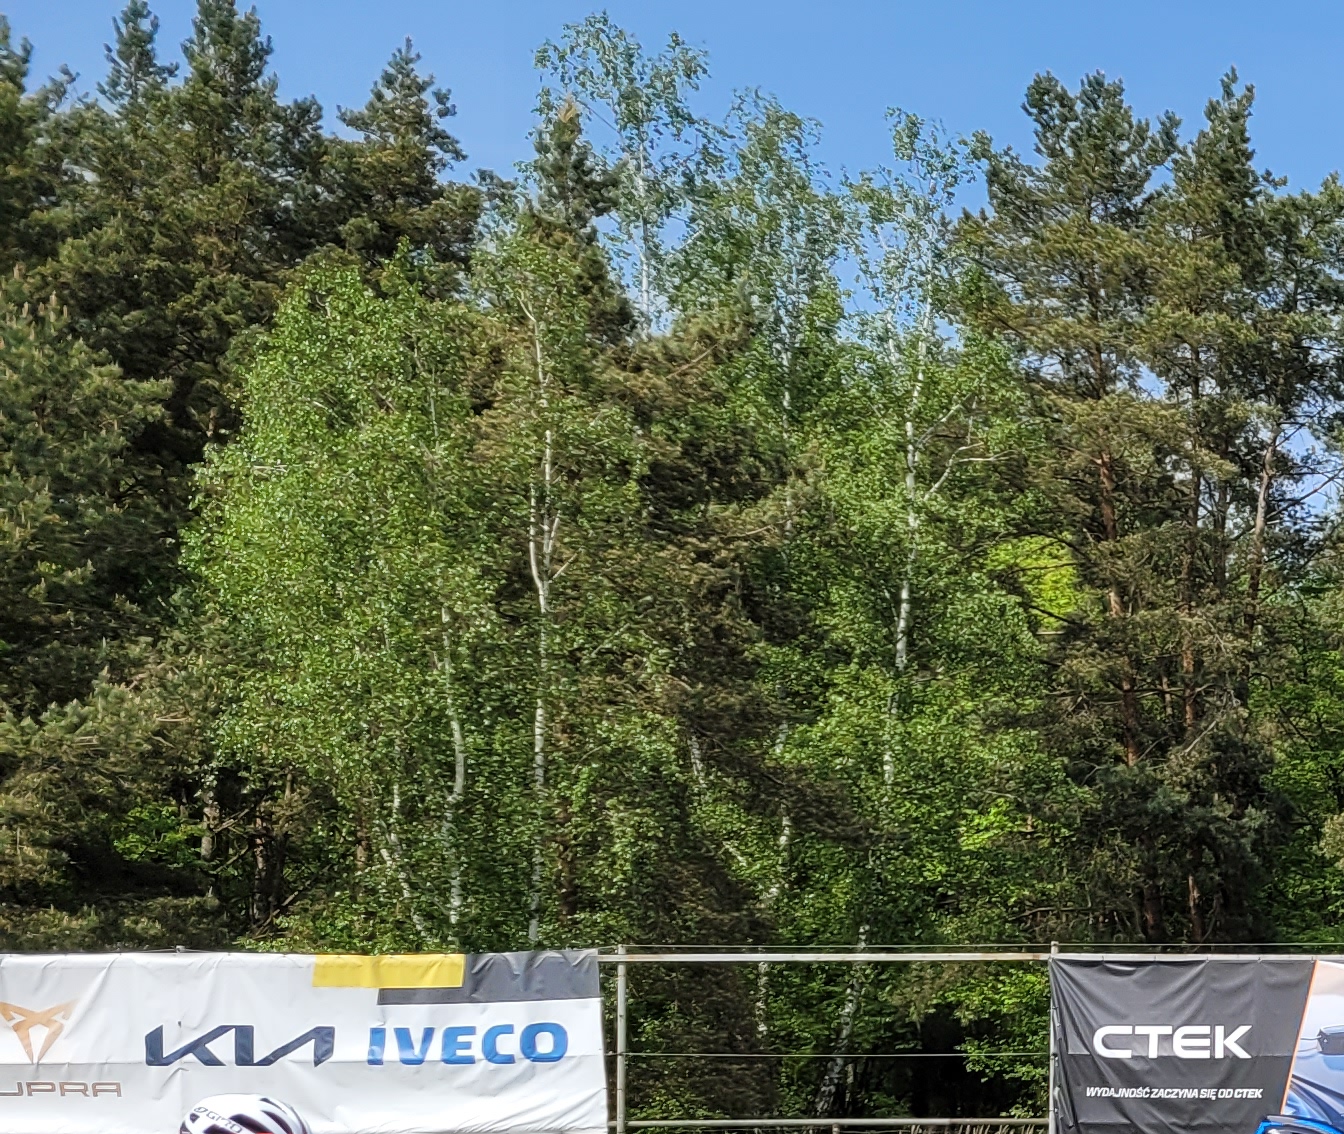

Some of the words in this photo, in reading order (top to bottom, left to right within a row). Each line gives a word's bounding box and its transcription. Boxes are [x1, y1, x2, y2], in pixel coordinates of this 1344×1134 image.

[367, 1022, 568, 1066] IVECO
[1092, 1024, 1254, 1060] CTEK
[0, 1081, 122, 1097] UPRA
[1085, 1086, 1151, 1099] WYDAJNOŚĆ
[1150, 1087, 1199, 1099] ZACZYNA
[1199, 1088, 1217, 1101] SIĘ
[1218, 1088, 1235, 1099] OD
[1234, 1088, 1264, 1099] CTEK
